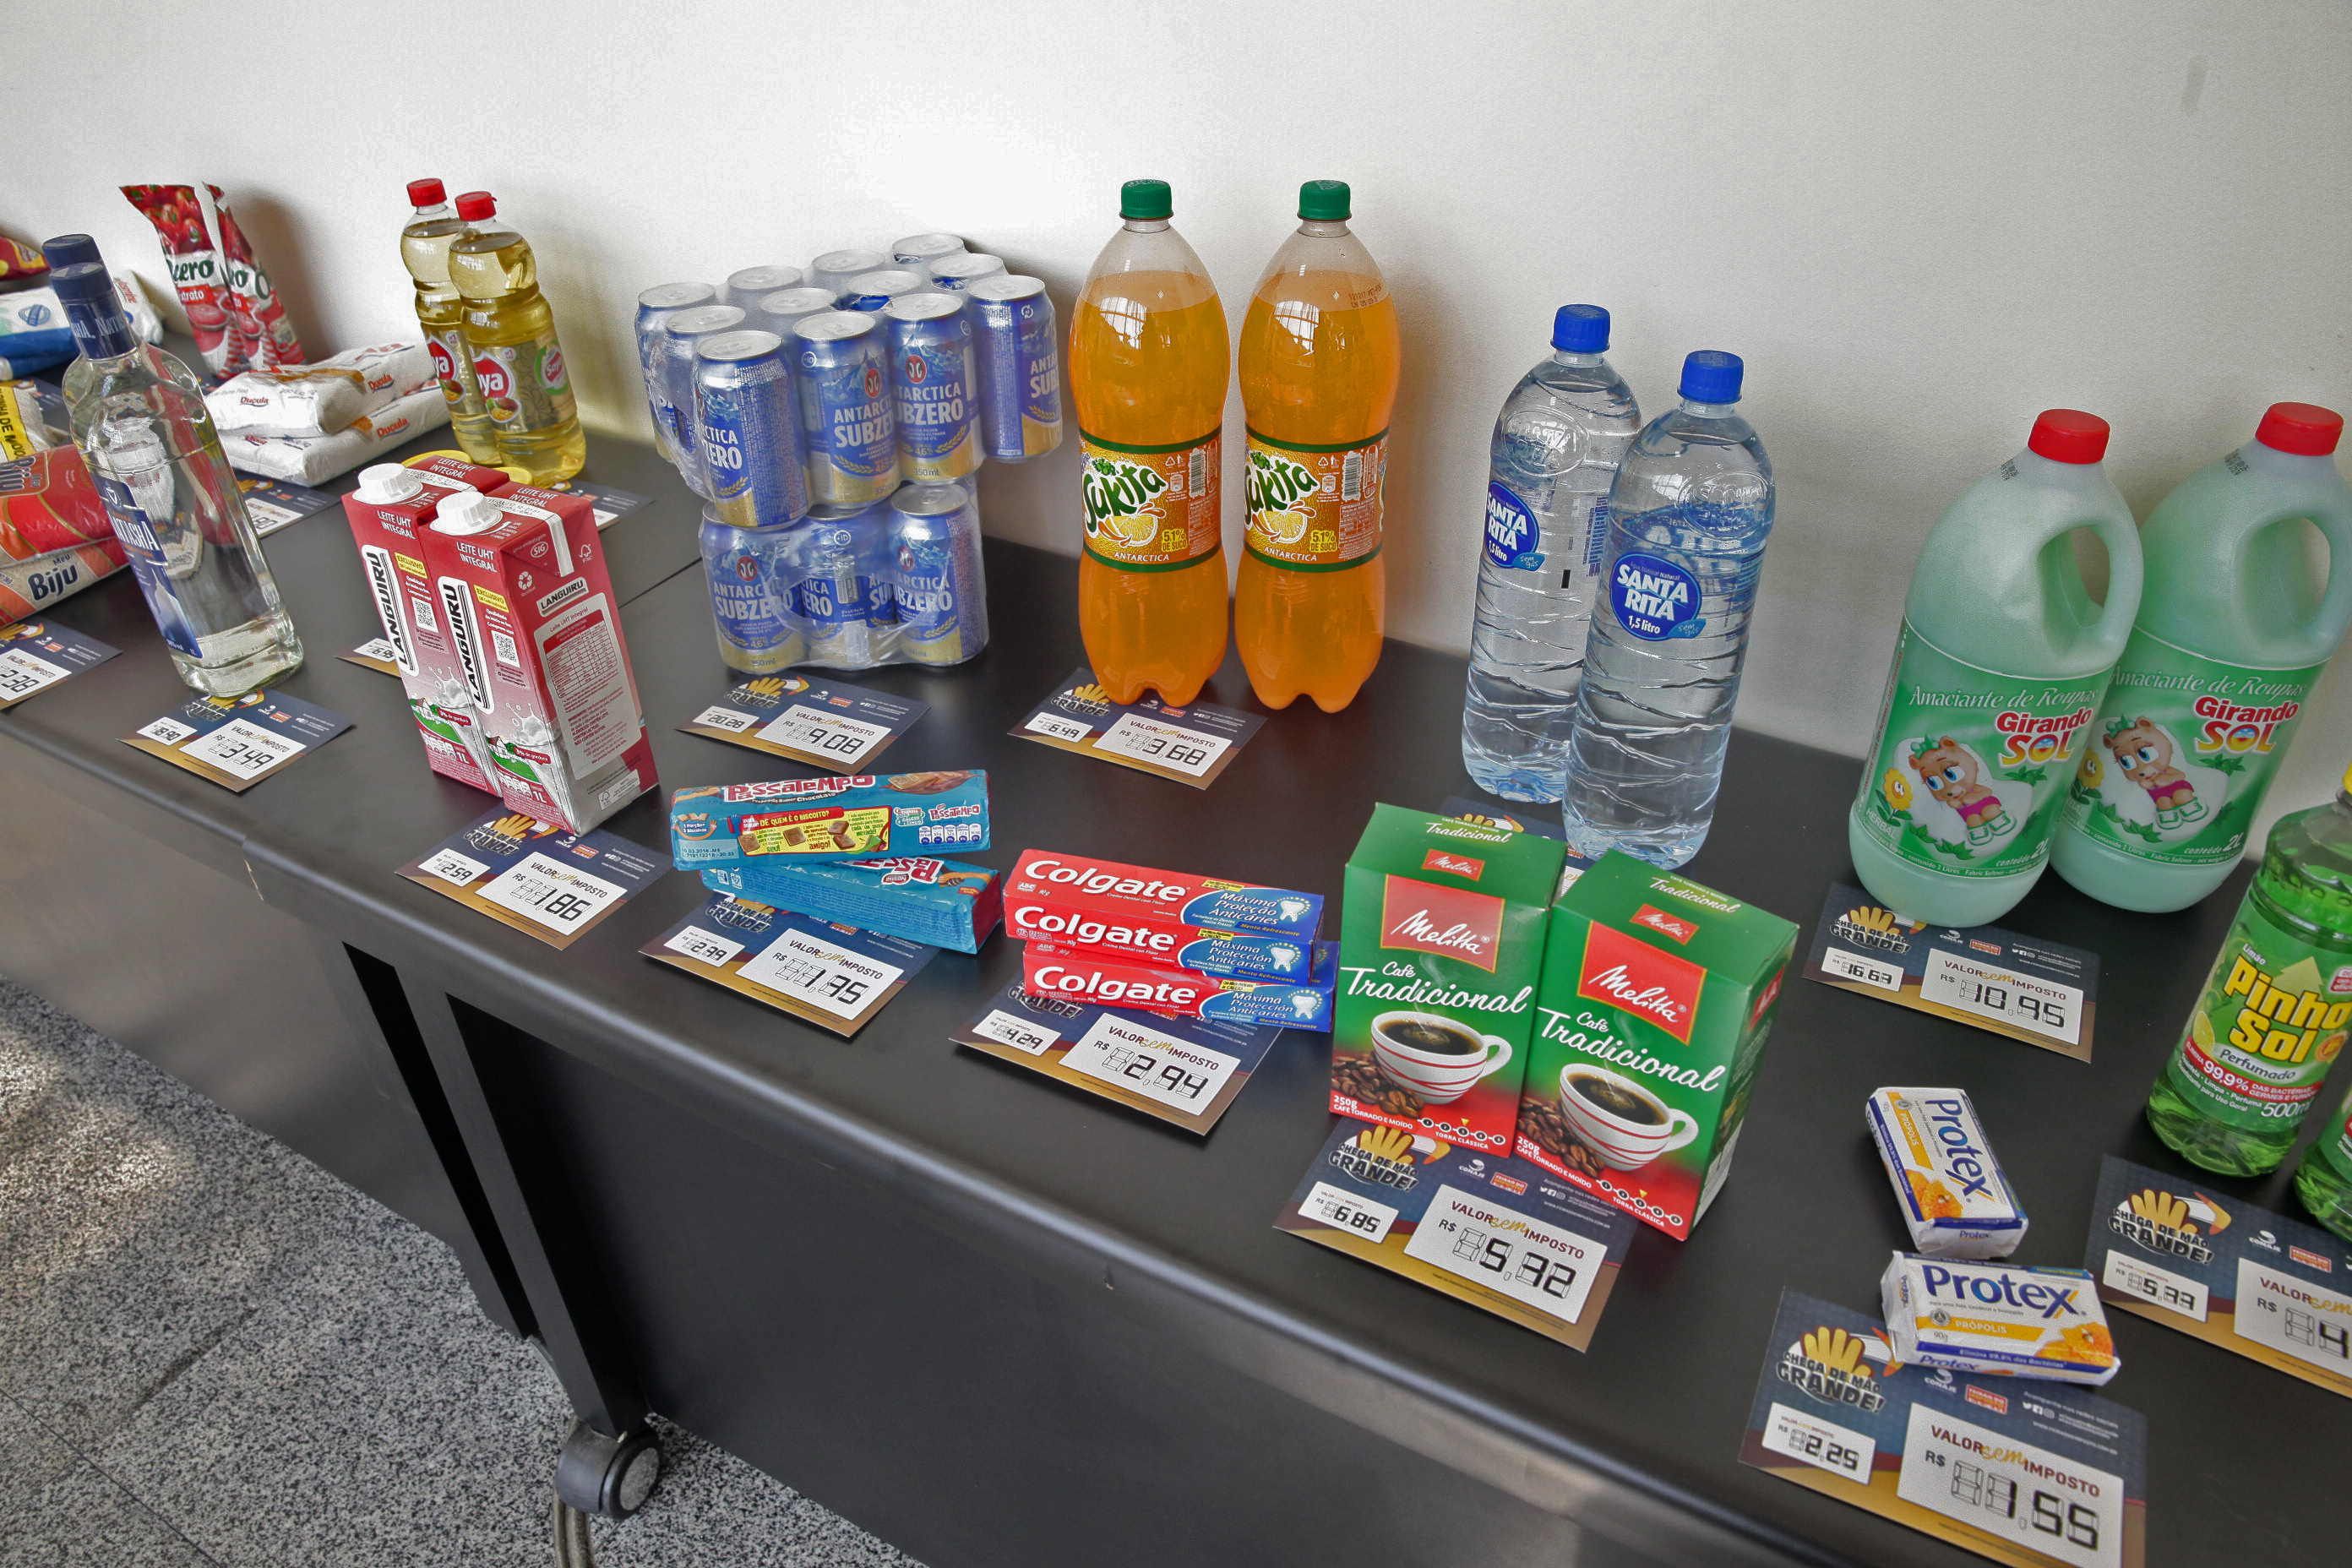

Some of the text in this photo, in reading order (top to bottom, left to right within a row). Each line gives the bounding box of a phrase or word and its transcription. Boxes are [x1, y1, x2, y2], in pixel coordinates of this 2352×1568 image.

[169, 259, 215, 282] uero
[898, 382, 961, 402] TARCTICA
[896, 398, 964, 426] UBZERO
[429, 464, 466, 479] INTEGRAL
[438, 457, 476, 472] LEITE UHT
[509, 493, 547, 508] INTEGRAL
[518, 487, 558, 501] LEITE UHT
[1083, 464, 1167, 533] Sukita
[1244, 460, 1318, 525] Sukita
[377, 509, 411, 529] LEITE UHT
[1487, 491, 1528, 536] SANTA
[381, 520, 416, 540] INTEGRAL
[1488, 520, 1518, 551] RITA
[456, 541, 494, 561] LEITE UHT
[1113, 551, 1170, 562] ANTARCTICA
[1172, 541, 1187, 549] SUCO
[1264, 547, 1318, 562] ANTARCTICA
[1320, 542, 1337, 551] SUCO
[1495, 543, 1508, 563] litro
[460, 553, 498, 573] INTEGRAL
[28, 564, 79, 602] Biju
[539, 579, 585, 610] LANGUIRU
[1617, 563, 1689, 604] SANTA
[366, 552, 409, 667] LANGUIRU
[1624, 587, 1676, 622] RITA
[1628, 614, 1661, 634] 1,5 litro
[442, 583, 483, 704] LANGUIRU
[2110, 665, 2307, 703] Amaciante de Roupas
[1908, 685, 2099, 711] Amaciante de Roupas
[2195, 695, 2300, 723] Girando
[796, 711, 875, 737] VALOR IMPOSTO
[1996, 706, 2093, 734] Girando
[262, 737, 291, 754] IMPOSTO
[1130, 721, 1217, 749] VALOR IMPOSTO
[2001, 729, 2076, 766] SOL
[2197, 720, 2277, 753] SOL
[760, 810, 830, 827] DE QUEM BISCOITO?
[1865, 808, 1896, 839] HERBAL
[1425, 821, 1514, 844] Tradicional
[1995, 855, 2030, 868] conteúdo
[2184, 847, 2222, 855] conteúdo
[1428, 855, 1473, 874] Melitta
[531, 862, 608, 899] VALOR IMPOSTO
[1025, 859, 1187, 902] Colgate
[1219, 891, 1277, 908] Máxima
[1648, 875, 1742, 914] Tradicional
[705, 904, 772, 933] GRANDE!
[1208, 907, 1280, 926] Anticáries
[1214, 900, 1277, 917] Proteção
[1014, 906, 1176, 952] Colgate
[1261, 925, 1301, 937] Refrescante
[1390, 909, 1484, 955] Melitta
[1637, 912, 1685, 938] Melitta
[1835, 918, 1908, 945] CHEGA DE MÃO
[1211, 939, 1261, 954] Máxima
[1830, 924, 1912, 956] GRANDE!
[772, 951, 787, 963] R$
[789, 939, 884, 980] VALOR IMPOSTO
[1206, 955, 1266, 971] Anticaries
[1208, 947, 1273, 964] Protección
[2242, 943, 2268, 966] Limão
[1257, 972, 1296, 984] Refrescante
[1381, 961, 1417, 978] Café
[1940, 973, 1957, 985] R$
[1944, 959, 2067, 1002] VALOR IMPOSTO
[1033, 966, 1197, 1005] Colgate
[1233, 992, 1282, 1005] Máxima
[1339, 966, 1534, 1014] Tradicional
[1587, 965, 1680, 1023] Melitta
[1228, 1006, 1288, 1020] Anticaries
[1230, 999, 1294, 1014] Protección
[1280, 1020, 1318, 1030] Refrescante
[1576, 1011, 1610, 1034] Café
[2228, 1007, 2320, 1064] Sol
[1093, 1040, 1109, 1052] R$
[1108, 1025, 1219, 1072] VALOR IMPOSTO
[1537, 1005, 1728, 1093] Tradicional
[2202, 1059, 2249, 1092] 99,9%
[2219, 1048, 2296, 1081] Perfumado
[1333, 1095, 1358, 1110] 250g
[2203, 1076, 2262, 1108] Limpa Perfuma
[1332, 1103, 1414, 1130] CAFÉ TORRADO MOÍDO
[2229, 1100, 2249, 1113] Geral
[1435, 1130, 1489, 1150] TORRA CLÁSSICA
[1899, 1113, 1919, 1147] PRÓPOLIS
[1517, 1135, 1540, 1157] 250g
[1925, 1098, 1995, 1201] Protex
[1328, 1150, 1419, 1193] GRANDE!
[1338, 1143, 1418, 1177] CHEGA DE MÃO
[1516, 1144, 1593, 1190] CAFÉ TORRADO MOÍDO
[1613, 1195, 1666, 1228] TORRA CLÁSSICA
[1438, 1218, 1456, 1233] R$
[1451, 1200, 1585, 1260] VALOR IMPOSTO
[1958, 1228, 1990, 1240] Protex
[2114, 1206, 2209, 1248] CHEGA DE MÃO
[2109, 1217, 2215, 1266] GRANDE!
[2248, 1236, 2282, 1253] CONAJE
[1920, 1264, 2080, 1320] Protex
[2259, 1276, 2313, 1304] VALOR
[2257, 1296, 2278, 1313] R$
[1954, 1318, 2008, 1336] PRÓPOLIS
[1783, 1352, 1881, 1394] CHEGA DE MÃO
[1919, 1354, 1981, 1371] Protex
[1776, 1361, 1886, 1414] GRANDE!
[1925, 1449, 1946, 1467] R$
[1931, 1424, 2101, 1498] VALOR IMPOSTO
